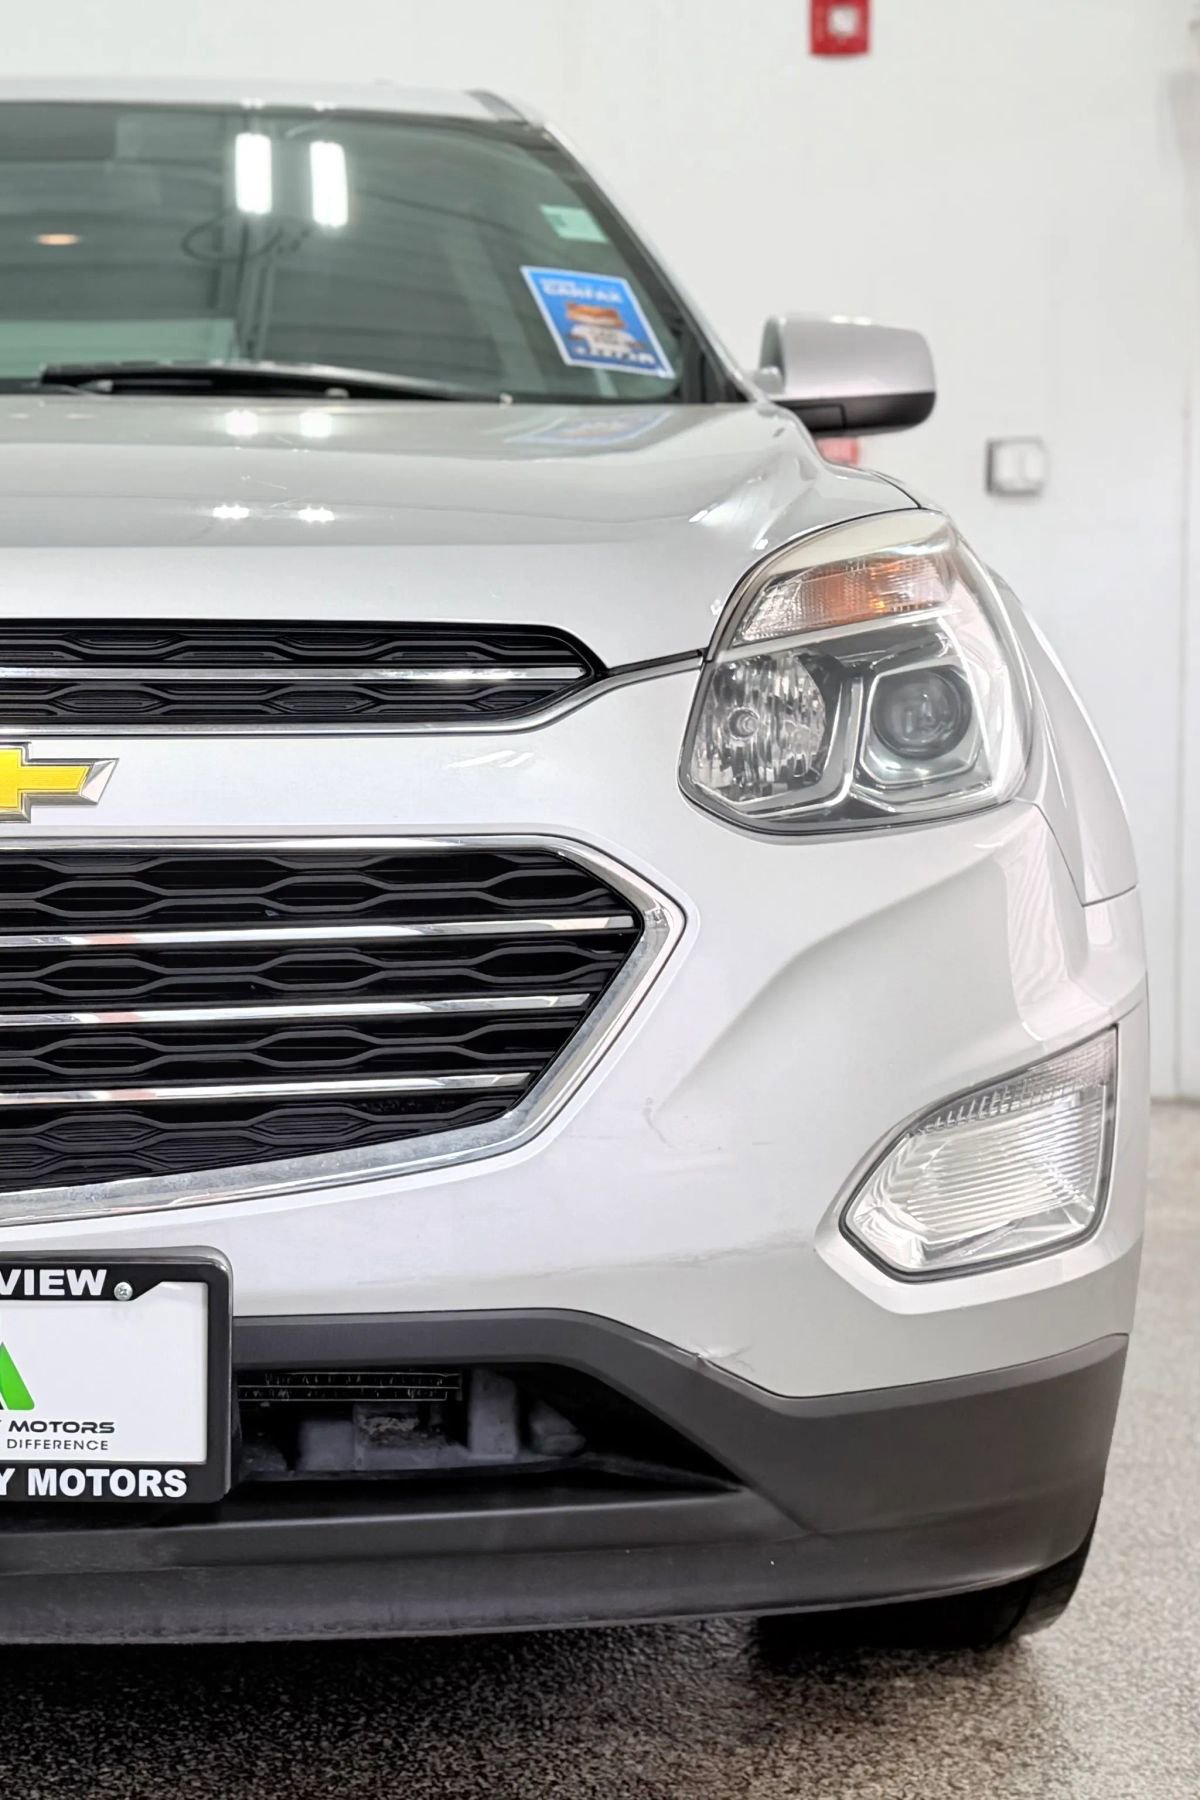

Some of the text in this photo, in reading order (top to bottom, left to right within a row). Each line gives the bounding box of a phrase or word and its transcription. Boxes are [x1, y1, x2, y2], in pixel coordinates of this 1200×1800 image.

[7, 1419, 116, 1434] MOTORS
[6, 1438, 108, 1451] DIFFERENCE
[27, 1468, 188, 1498] MOTORS
